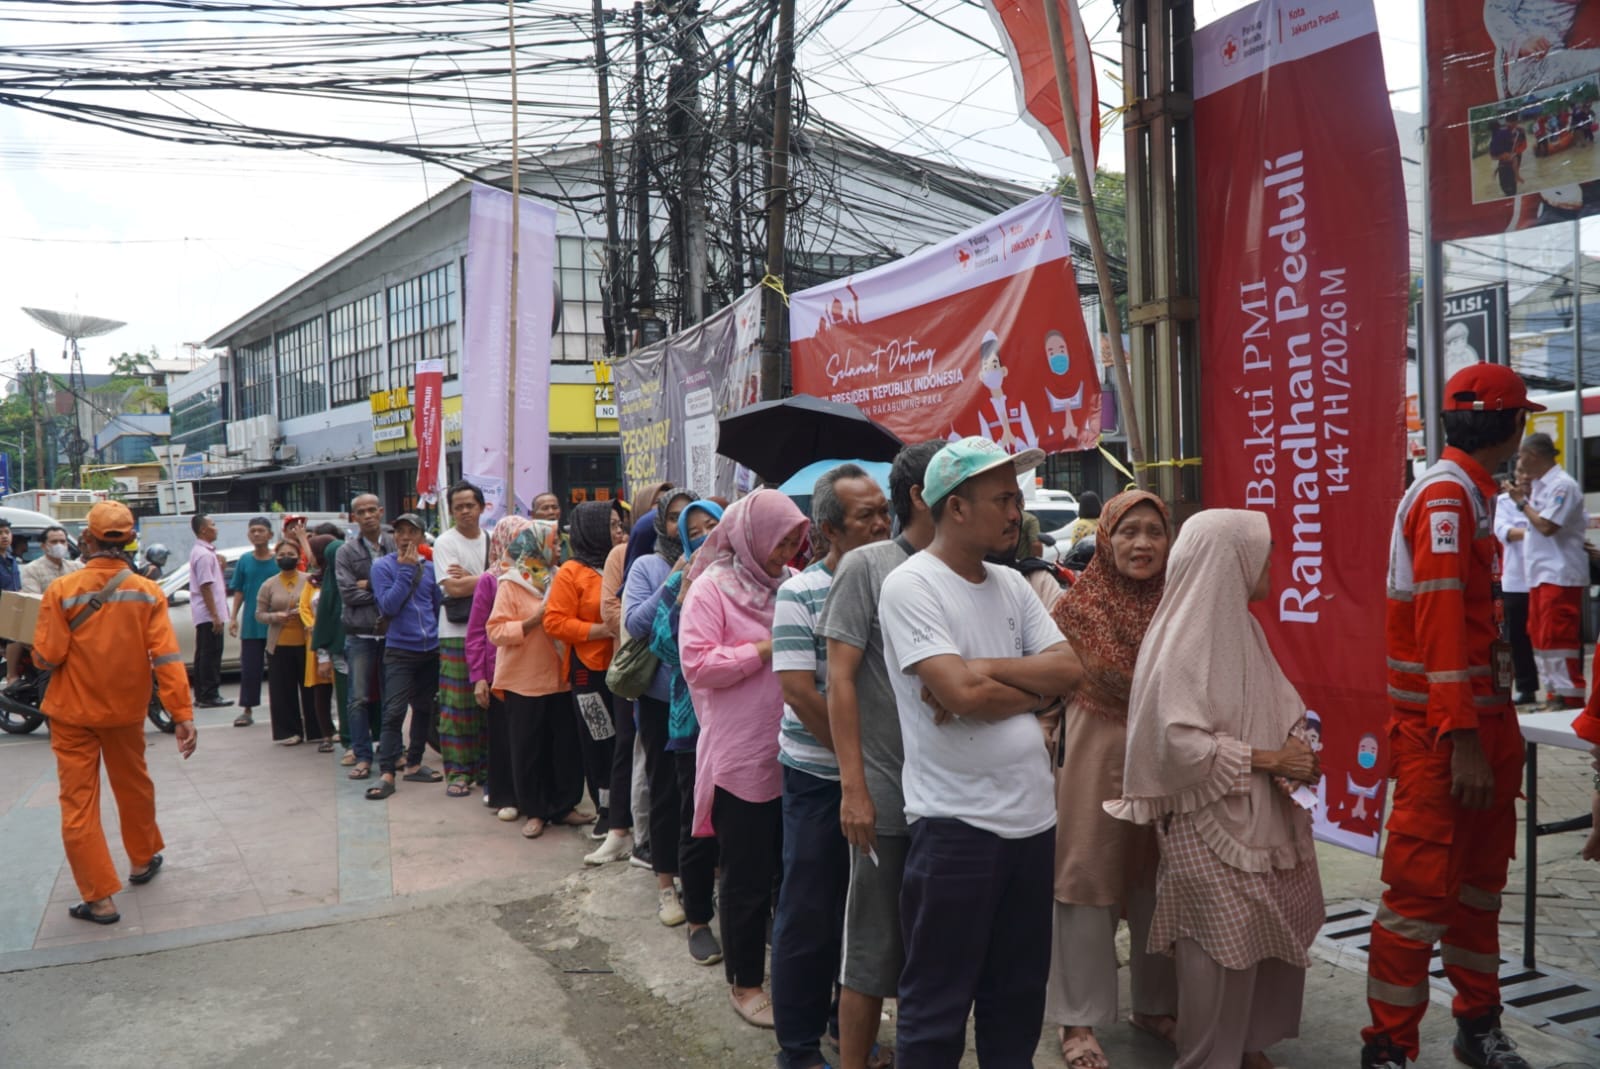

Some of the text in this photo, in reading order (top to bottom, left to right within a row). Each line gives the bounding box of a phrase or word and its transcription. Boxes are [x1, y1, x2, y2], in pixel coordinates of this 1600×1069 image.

[1289, 8, 1305, 20] Kota
[1291, 10, 1341, 36] Jakarta Pusat
[1443, 296, 1482, 316] OLISI
[831, 370, 964, 403] PRESIDEN REPUBLIK INDONESIA
[1239, 277, 1277, 509] Bakti PMI
[1263, 150, 1323, 623] Ramadhan Peduli
